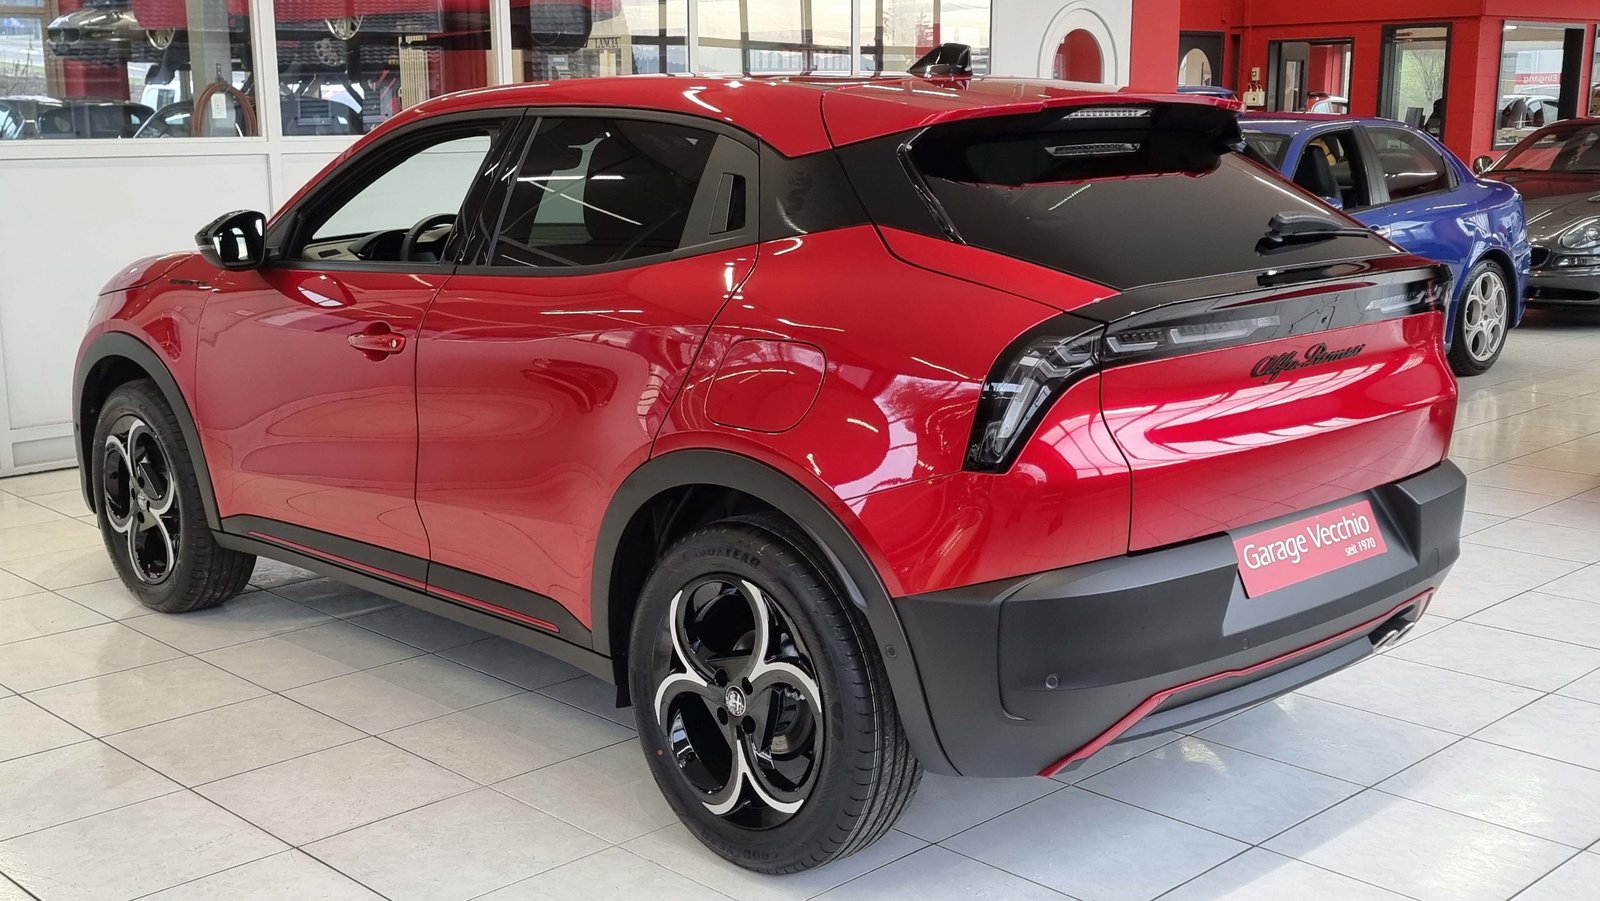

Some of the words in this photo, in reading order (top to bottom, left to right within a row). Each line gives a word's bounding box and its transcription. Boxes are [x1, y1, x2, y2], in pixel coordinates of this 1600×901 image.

[1250, 350, 1298, 385] Alfa
[1304, 342, 1366, 366] Romeo
[681, 545, 762, 569] ODYEAR
[1243, 534, 1309, 569] Garage
[1306, 512, 1370, 549] Vecchio
[1344, 544, 1358, 557] seit
[1358, 537, 1377, 553] 1970
